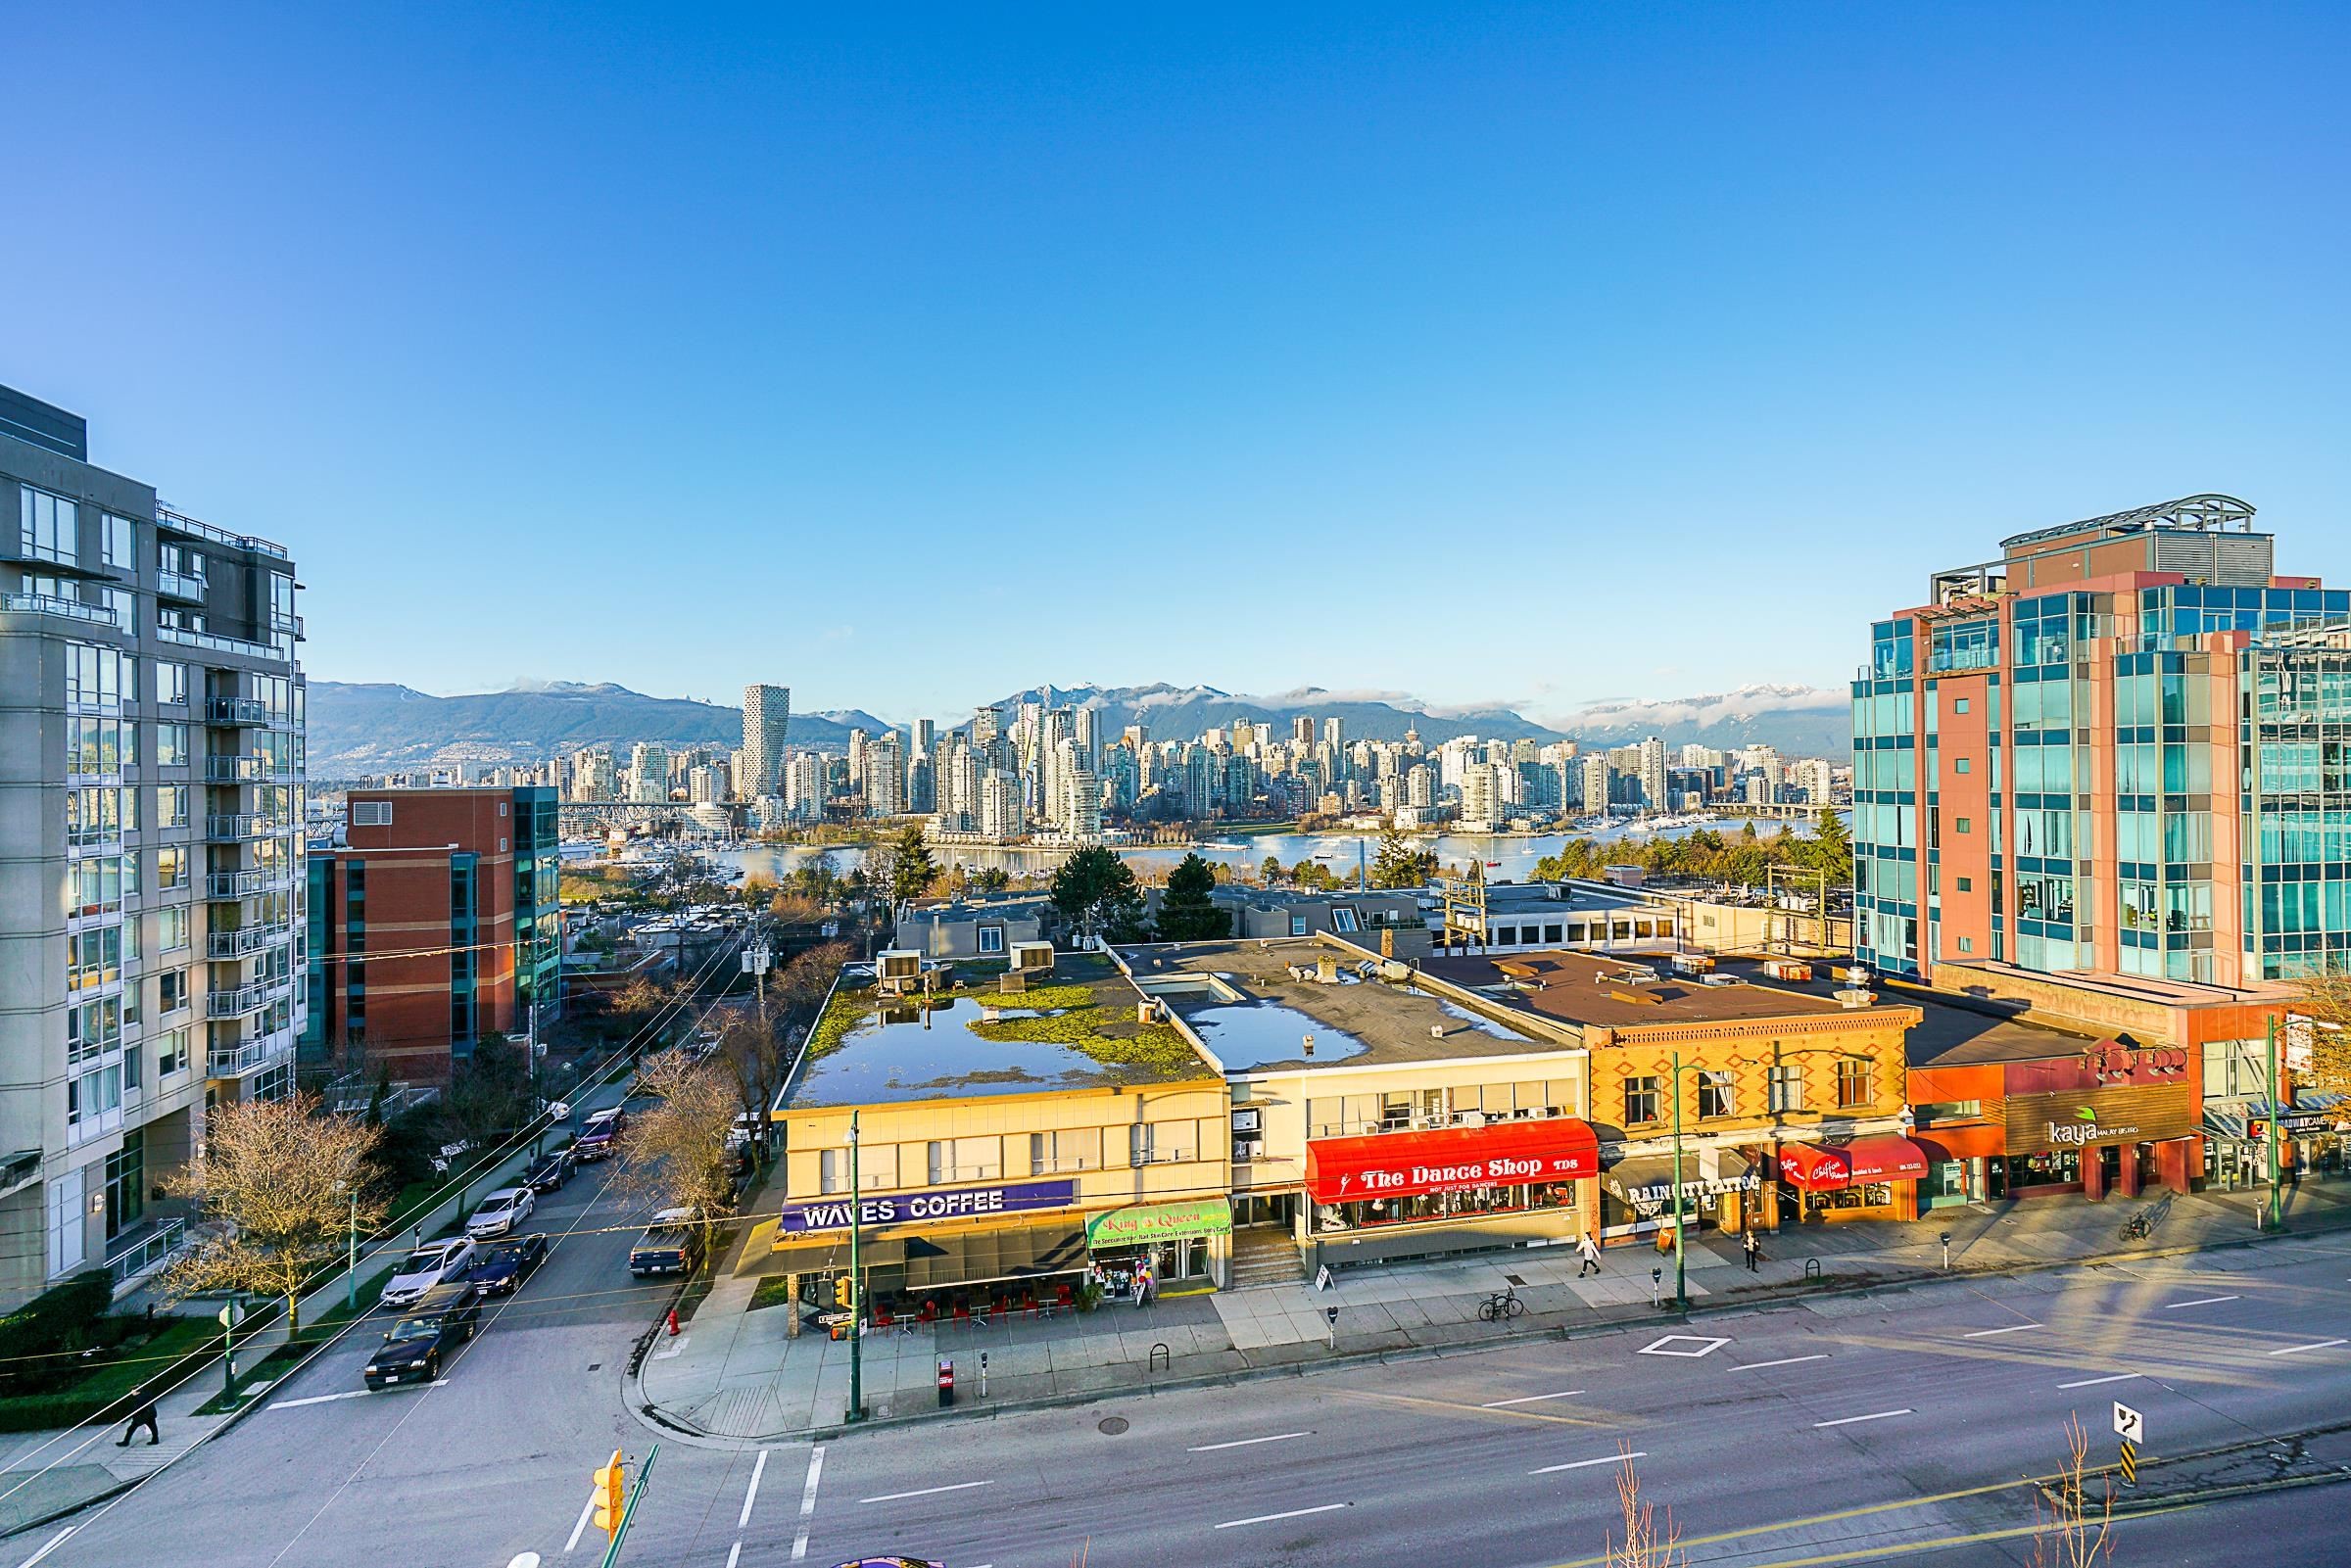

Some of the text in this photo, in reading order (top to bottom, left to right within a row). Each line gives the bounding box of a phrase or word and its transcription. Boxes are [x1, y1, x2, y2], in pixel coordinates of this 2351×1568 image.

[2048, 1121, 2097, 1145] kaya
[1361, 1159, 1578, 1189] The Dance Shop TDS
[1812, 1160, 1841, 1180] Chiffon
[1627, 1185, 1671, 1204] RAIN
[803, 1190, 1003, 1227] WAVES COFFEE
[1103, 1217, 1137, 1232] King
[1157, 1212, 1200, 1228] Queen
